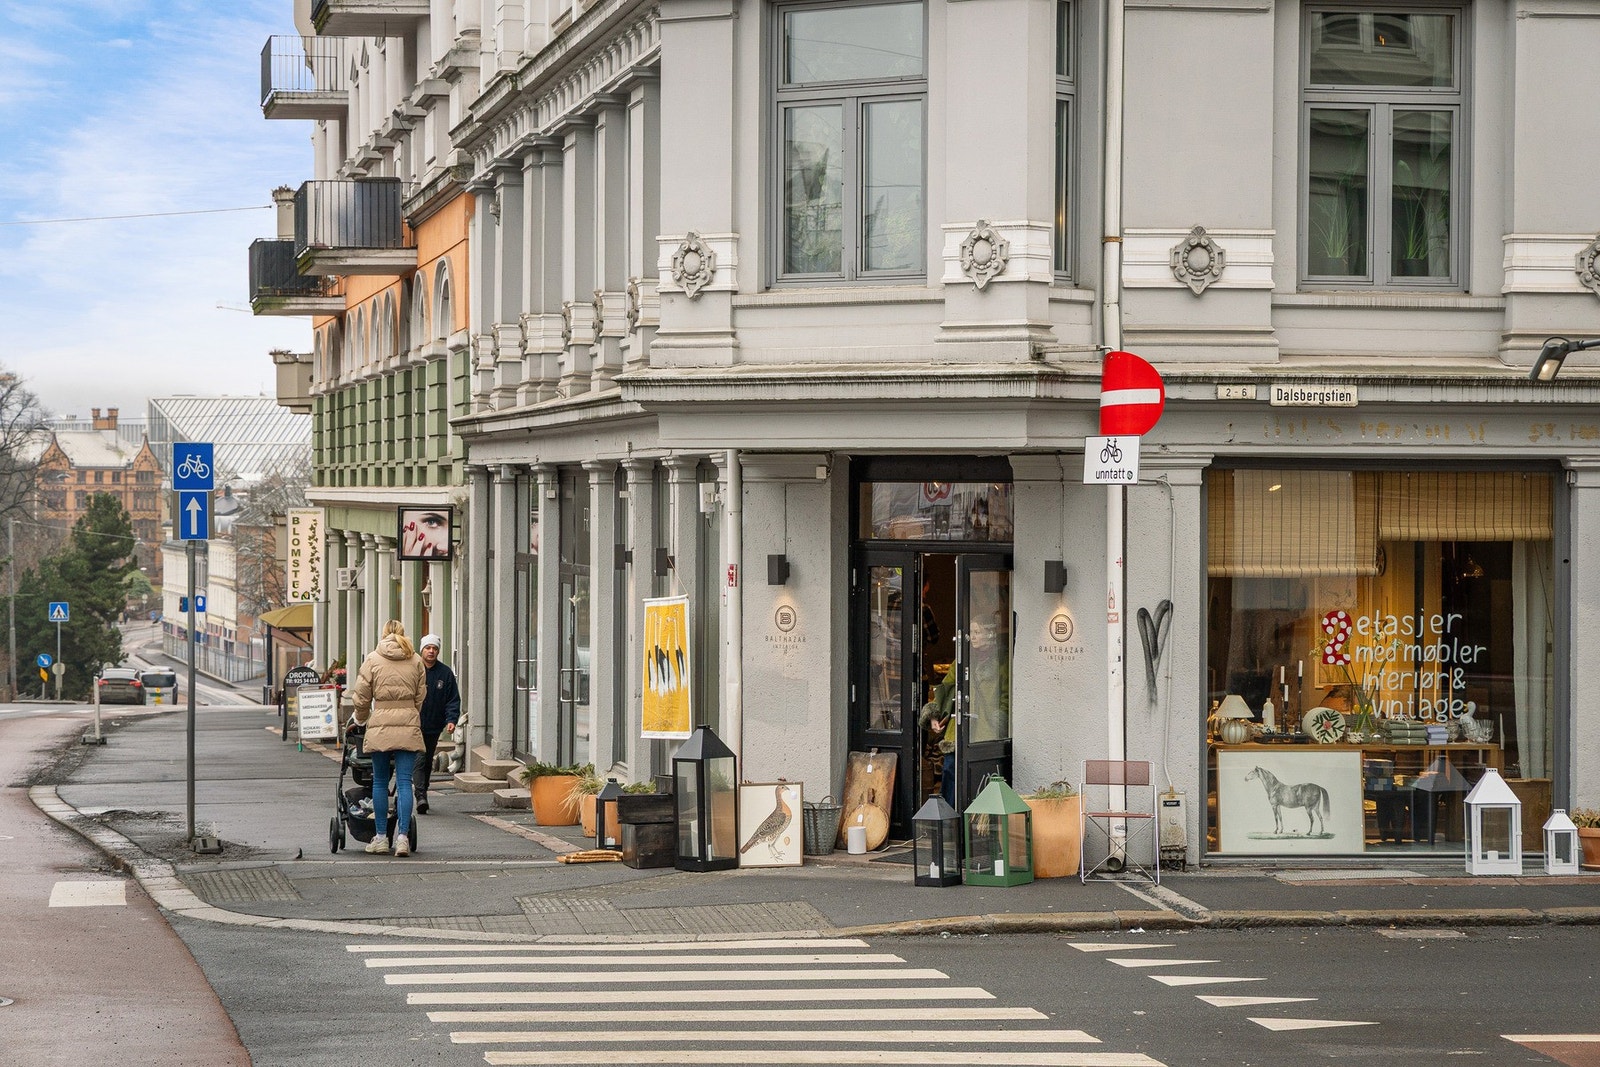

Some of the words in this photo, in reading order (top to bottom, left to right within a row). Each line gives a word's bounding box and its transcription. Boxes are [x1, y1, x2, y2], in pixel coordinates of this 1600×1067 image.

[1276, 388, 1352, 404] Dalsbergstien
[1095, 468, 1126, 480] unntatt
[1322, 610, 1352, 666] 2
[1356, 608, 1463, 638] etasjer
[1355, 638, 1398, 663] med
[1403, 637, 1487, 664] møbler
[1372, 694, 1464, 723] vintage
